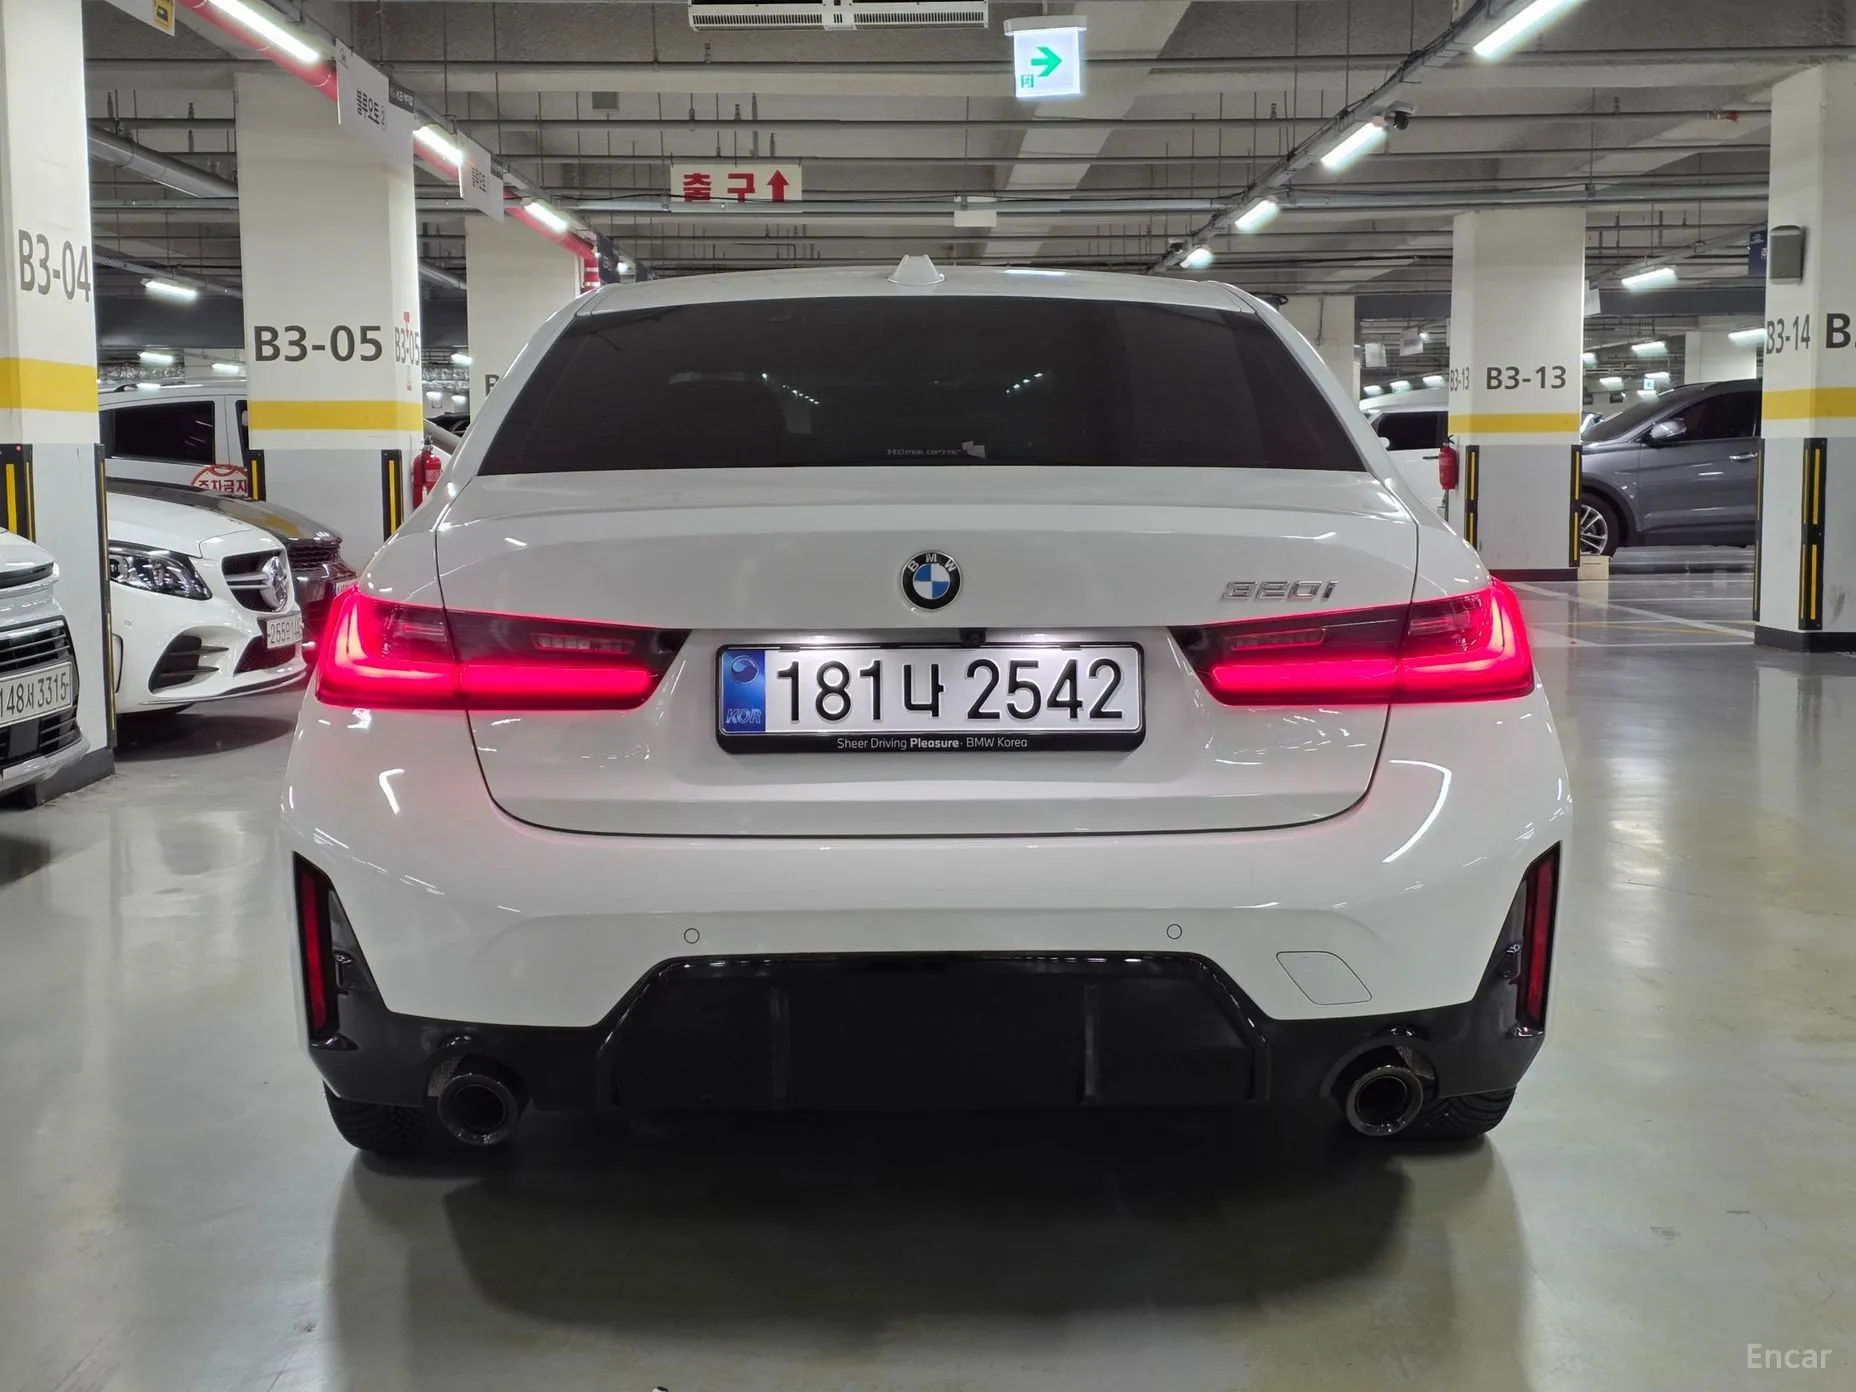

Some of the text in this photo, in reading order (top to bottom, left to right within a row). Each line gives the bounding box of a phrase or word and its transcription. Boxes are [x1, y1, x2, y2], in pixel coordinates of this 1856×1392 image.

[18, 229, 91, 303] B3-04
[254, 325, 383, 362] B3-05
[395, 326, 419, 366] B3-05
[1766, 314, 1811, 355] B3-14
[1826, 313, 1856, 349] B
[1450, 366, 1470, 392] B3-13
[1486, 366, 1567, 390] B3-13
[907, 553, 957, 573] BMW
[1222, 580, 1338, 601] 320i
[966, 658, 1123, 720] 2542
[726, 708, 762, 724] KOR
[837, 738, 868, 749] Sheer
[871, 738, 907, 750] Driving
[966, 737, 995, 748] BMW
[997, 736, 1028, 748] Korea
